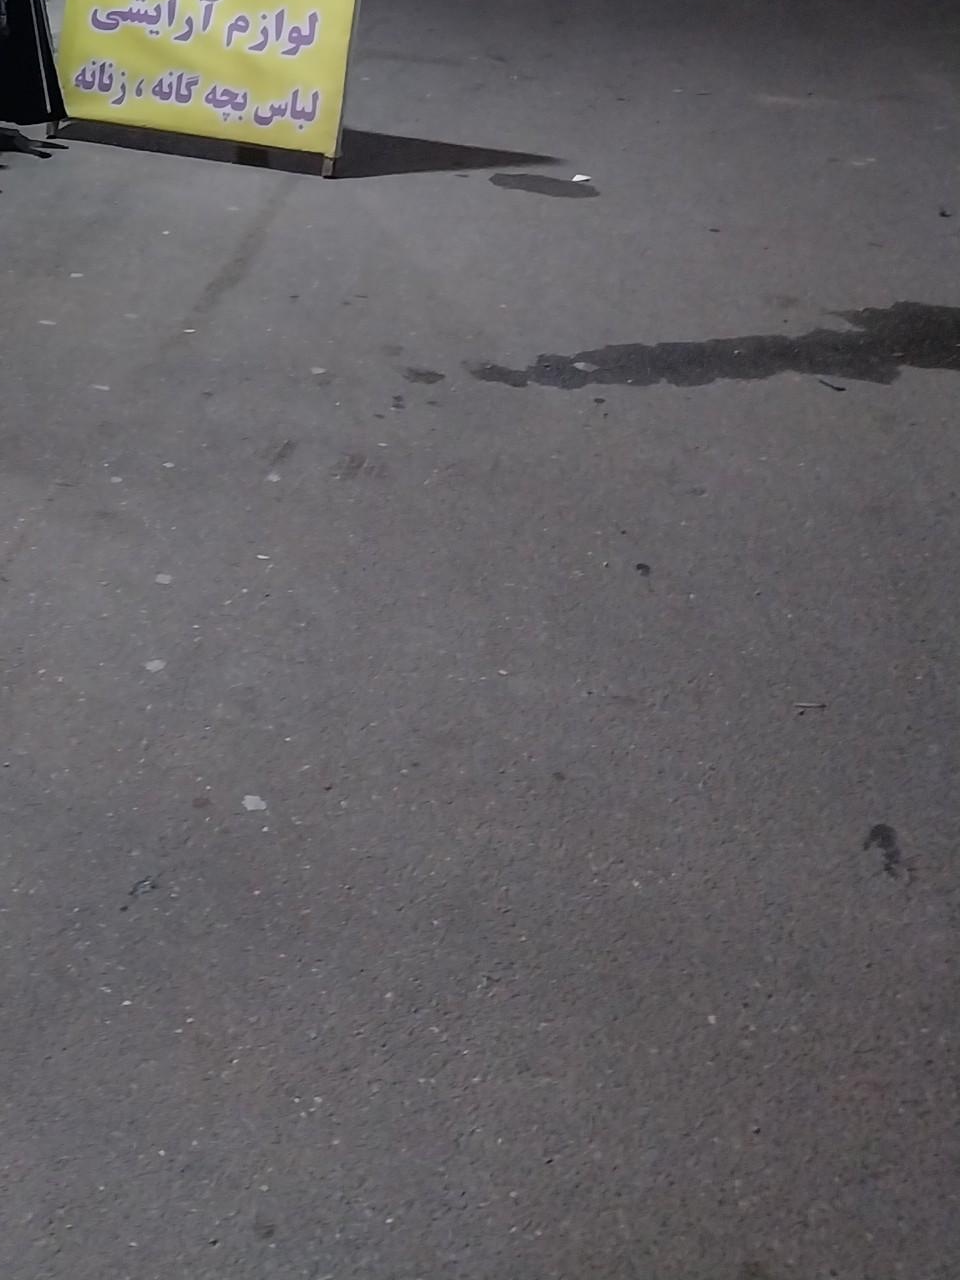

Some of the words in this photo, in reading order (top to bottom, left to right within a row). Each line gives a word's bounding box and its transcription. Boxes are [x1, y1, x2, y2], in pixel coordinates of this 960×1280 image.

[227, 8, 318, 56] لوازم
[74, 60, 127, 106] زنانه
[205, 89, 248, 122] بچه
[254, 89, 320, 130] لباس
